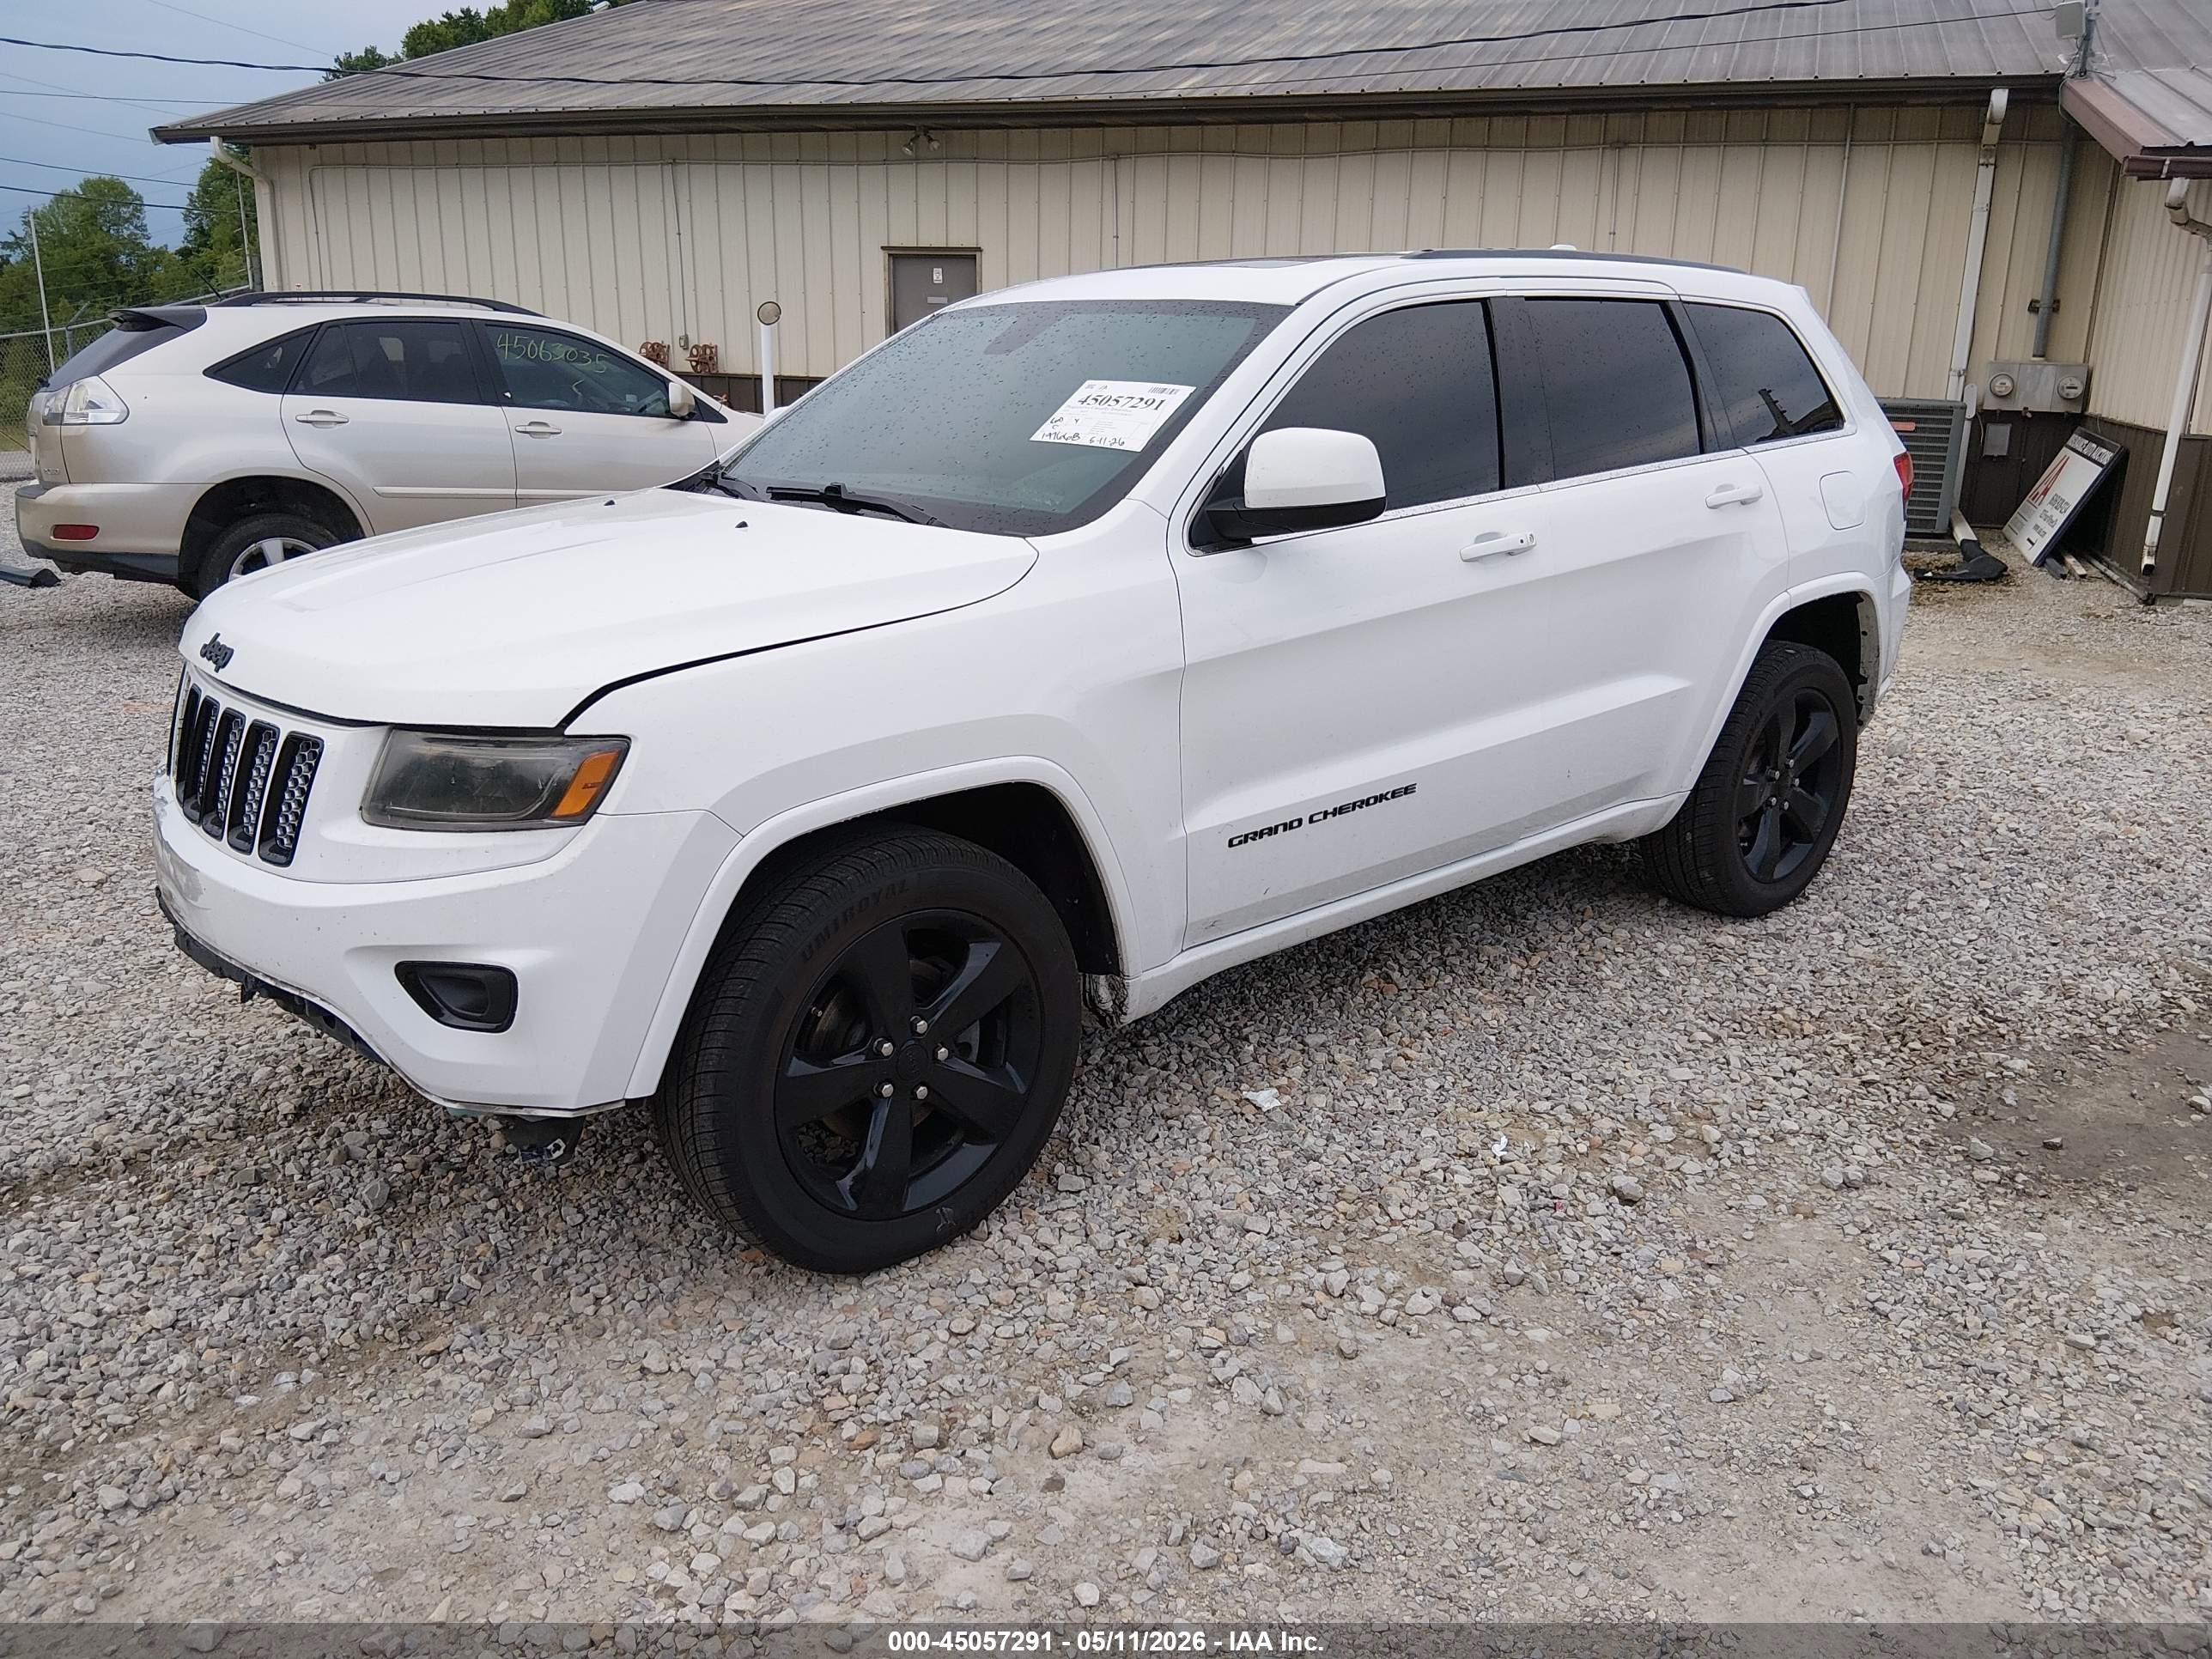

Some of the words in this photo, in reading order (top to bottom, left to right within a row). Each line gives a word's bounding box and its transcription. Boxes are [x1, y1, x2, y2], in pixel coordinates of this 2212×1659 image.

[496, 333, 611, 374] 45063035
[1078, 394, 1166, 410] 45057291
[199, 632, 234, 674] Jeep
[1228, 817, 1304, 848] GRAND
[1308, 782, 1418, 825] CHEROKEE
[802, 879, 911, 962] UNIROYAL
